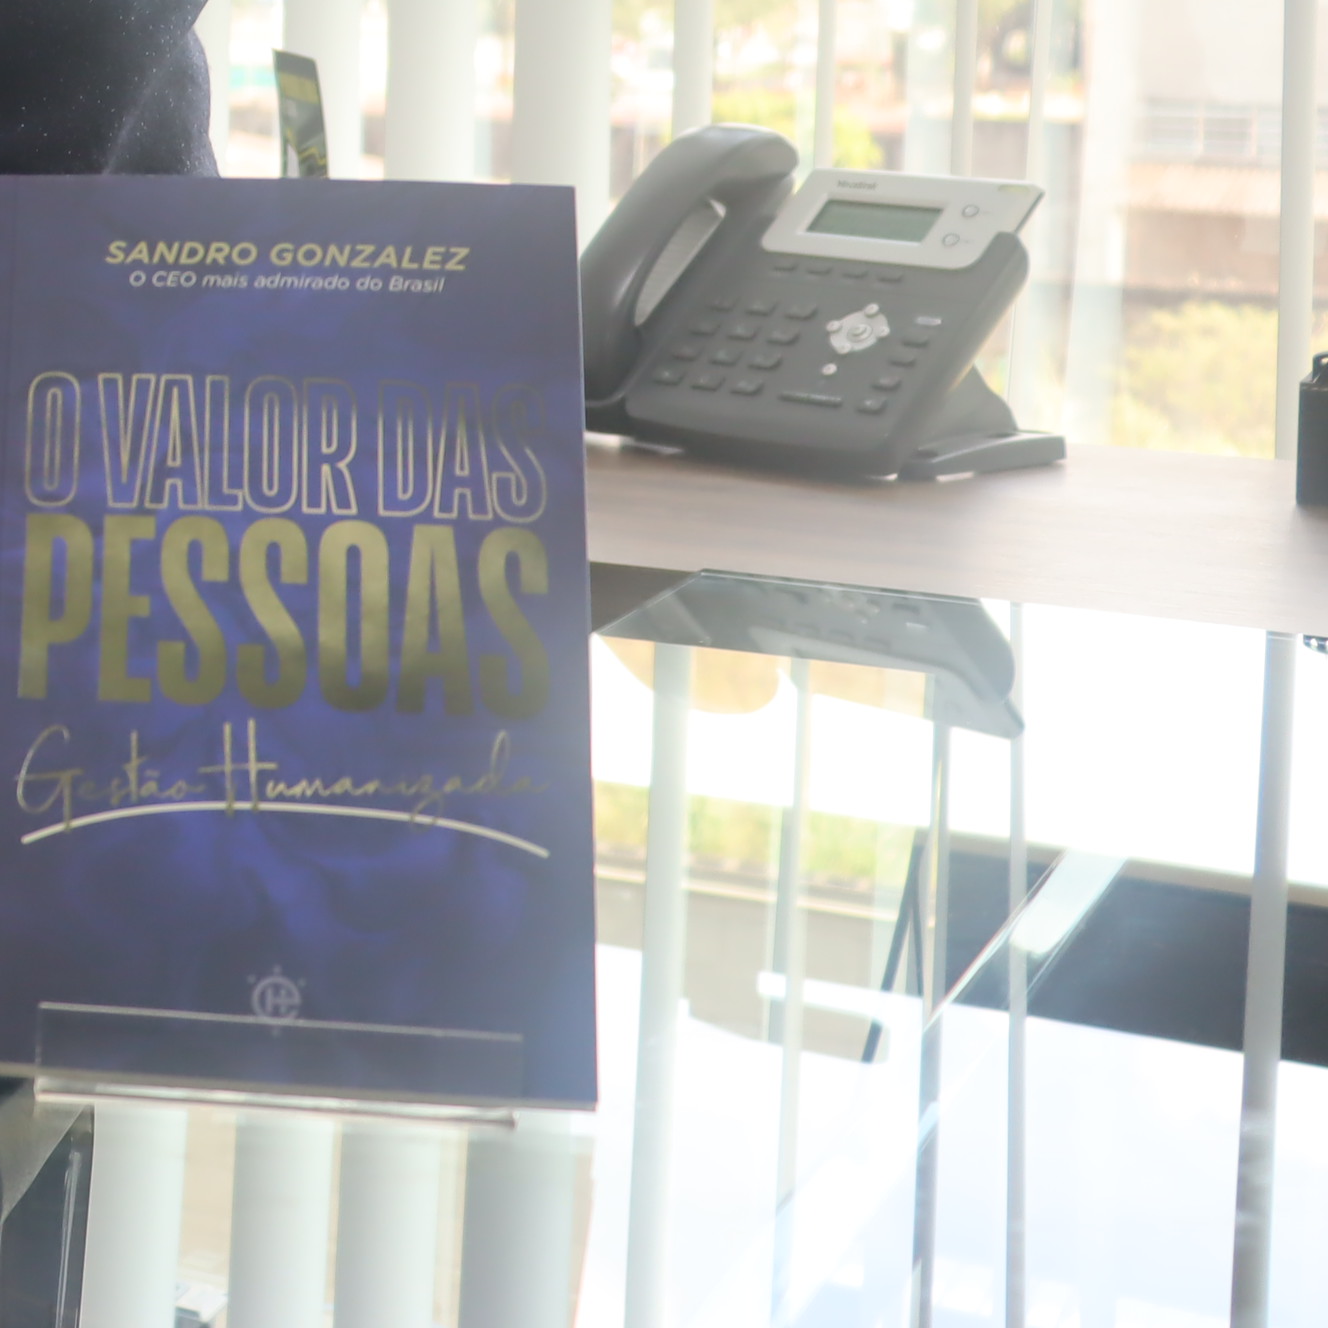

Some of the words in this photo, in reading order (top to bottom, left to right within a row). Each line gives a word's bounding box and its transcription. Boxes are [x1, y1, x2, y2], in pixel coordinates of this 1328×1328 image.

[105, 241, 258, 266] SANDRO
[270, 243, 470, 271] GONZALEZ
[129, 270, 146, 288] O
[152, 271, 197, 288] CEO
[202, 272, 248, 289] mais
[254, 272, 350, 290] admirado
[356, 275, 382, 291] do
[389, 276, 446, 293] Brasil
[24, 371, 81, 508] O
[98, 373, 358, 515] VALOR
[378, 378, 547, 523] DAS
[17, 513, 549, 721] PESSOAS
[14, 723, 205, 832] Gestão
